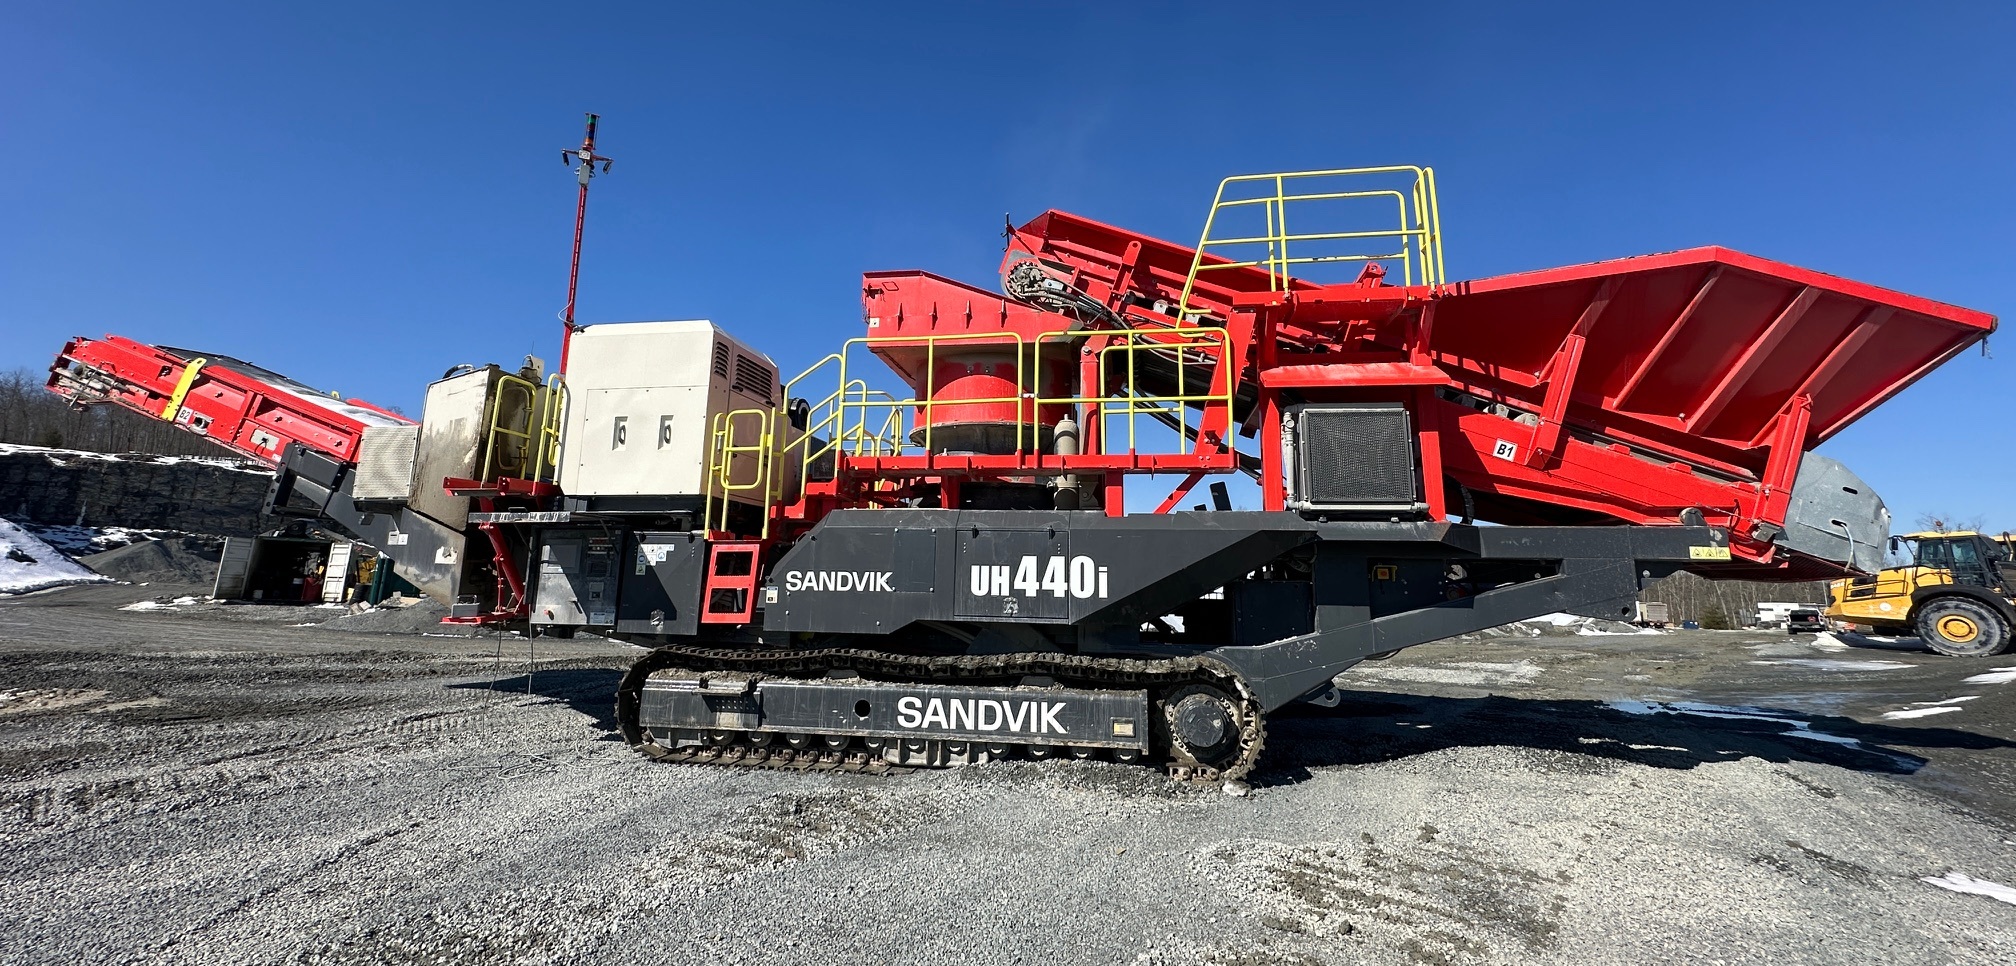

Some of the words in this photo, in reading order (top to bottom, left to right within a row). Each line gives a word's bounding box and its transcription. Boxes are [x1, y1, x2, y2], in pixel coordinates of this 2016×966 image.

[179, 409, 190, 420] B2
[1497, 443, 1513, 457] B1
[785, 570, 893, 592] SANDVIK
[896, 696, 1068, 734] SANDVIK
